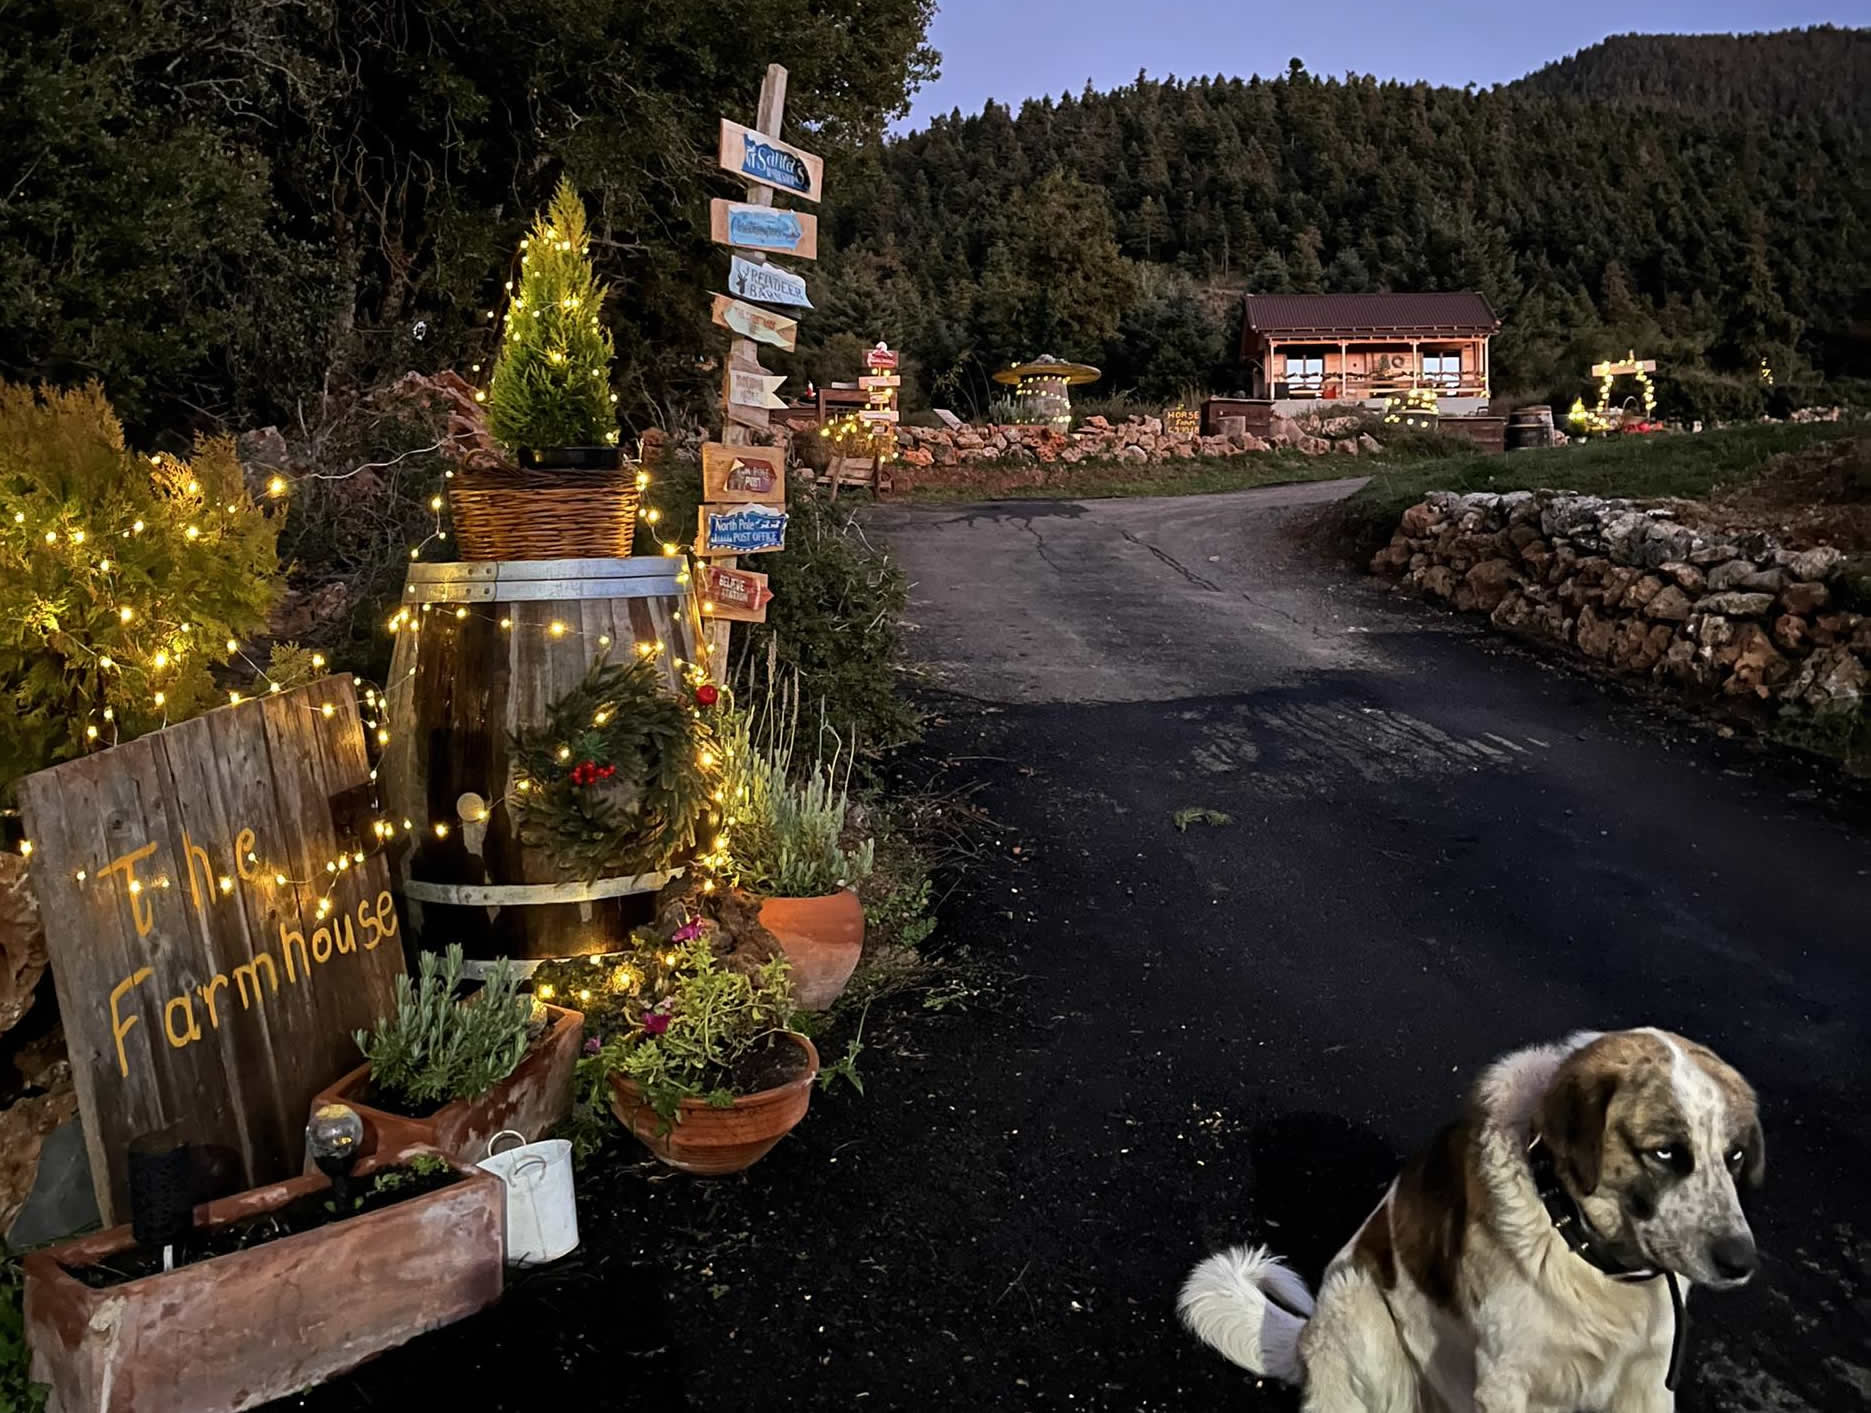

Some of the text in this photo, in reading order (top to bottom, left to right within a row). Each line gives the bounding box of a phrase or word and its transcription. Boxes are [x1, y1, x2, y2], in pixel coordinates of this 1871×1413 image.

[751, 268, 804, 300] REINDEER
[1167, 411, 1200, 420] HORSE
[715, 518, 755, 531] North Pole
[733, 531, 778, 543] POST OFFICE
[719, 574, 746, 592] BELIEVE
[96, 828, 256, 938] The
[110, 890, 398, 1077] Farmhouse
